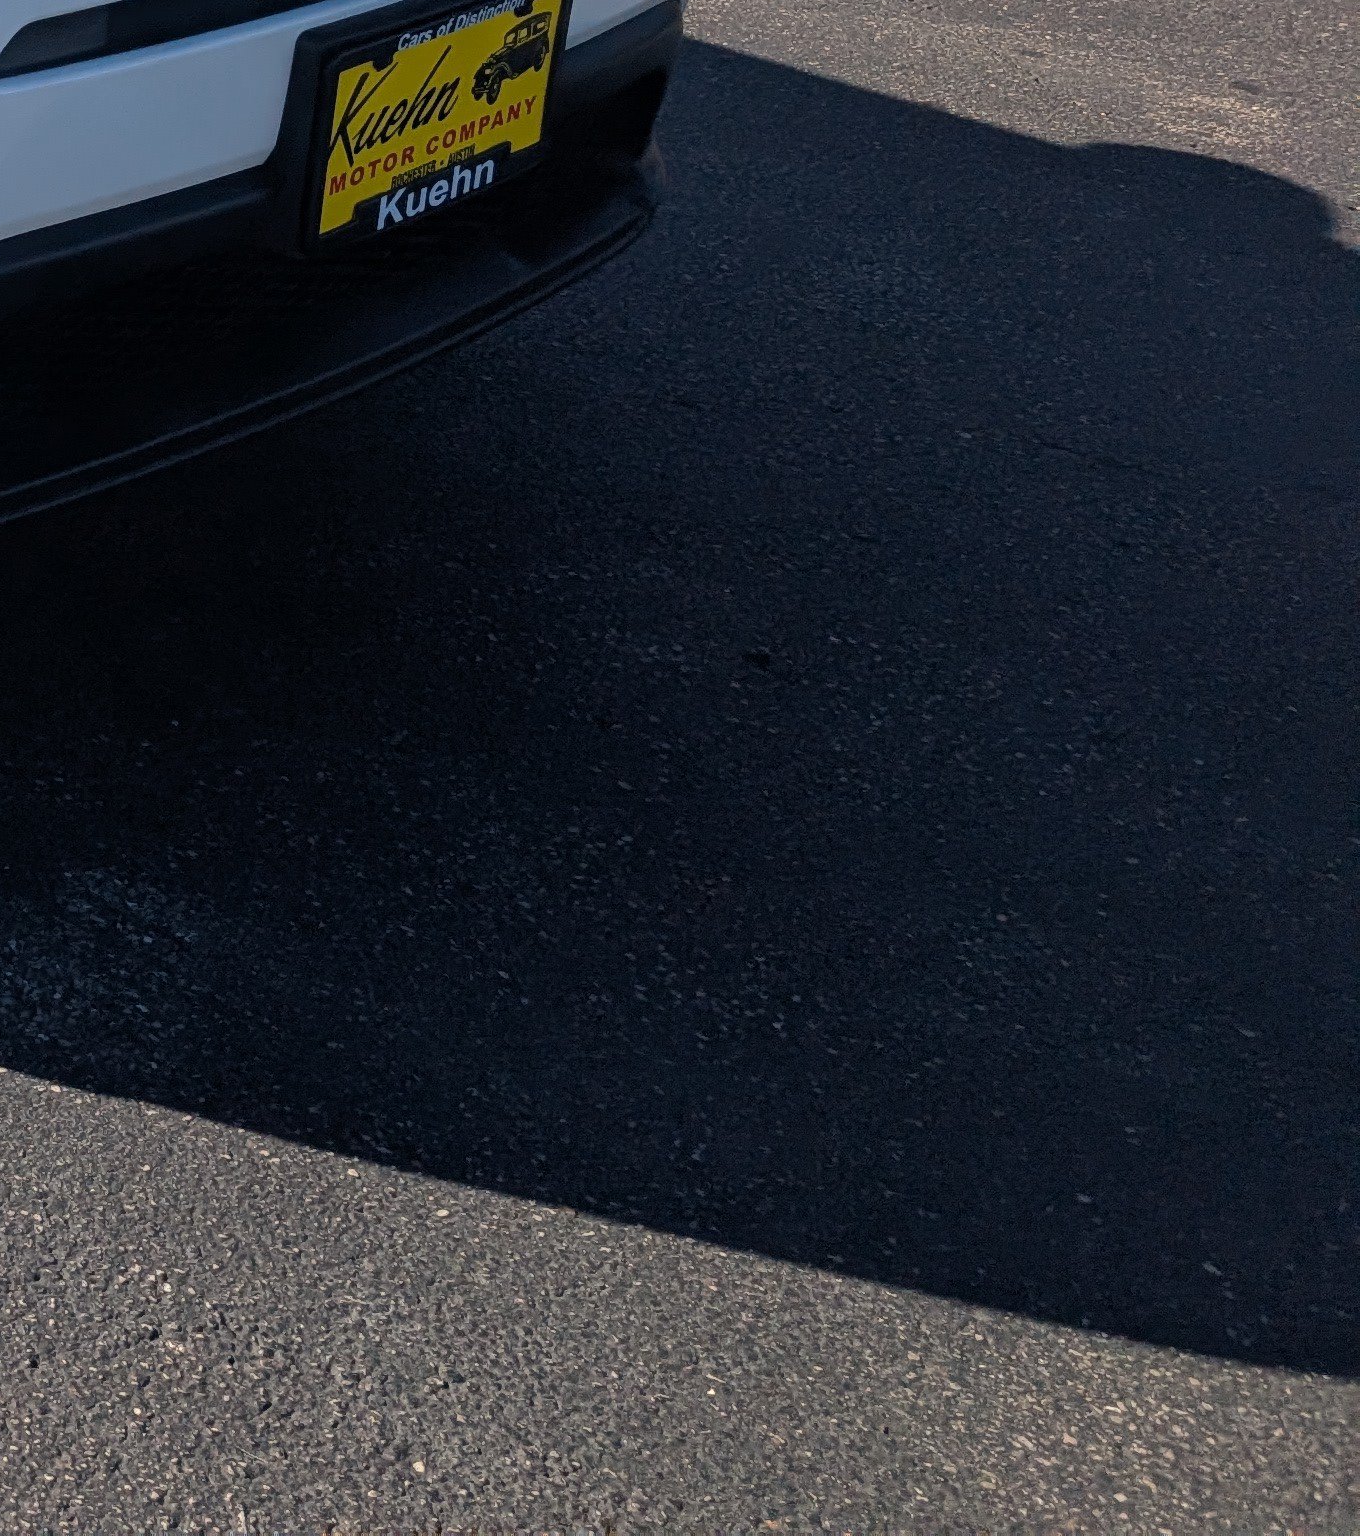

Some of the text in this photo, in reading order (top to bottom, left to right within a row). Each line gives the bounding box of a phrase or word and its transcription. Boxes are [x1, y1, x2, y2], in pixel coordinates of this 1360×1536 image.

[397, 32, 432, 52] Cars
[436, 21, 452, 39] of
[329, 44, 461, 168] Kuehn
[329, 95, 537, 196] MOTOR COMPANY
[377, 159, 495, 231] Kuehn
